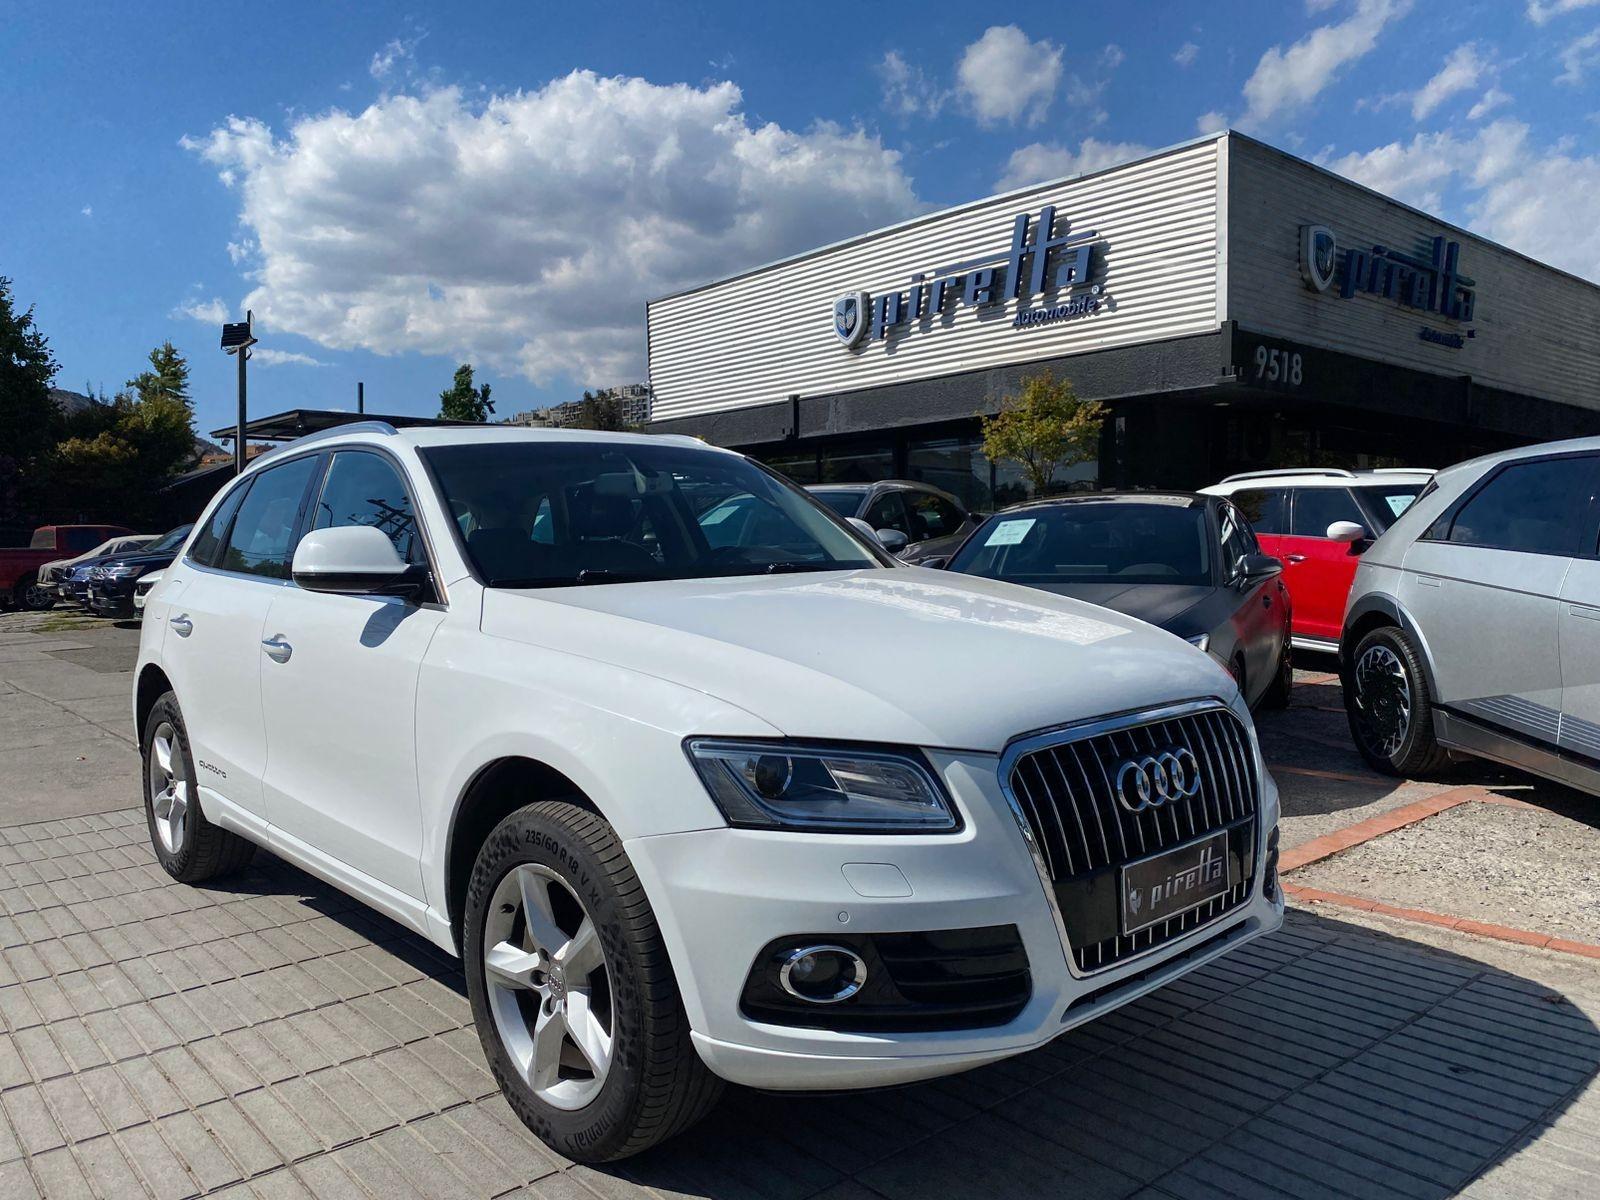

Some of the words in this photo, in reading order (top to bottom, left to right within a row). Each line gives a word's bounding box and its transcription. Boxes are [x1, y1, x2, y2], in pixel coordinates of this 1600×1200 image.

[872, 205, 1097, 341] piretta
[1013, 294, 1097, 326] Automobile
[1255, 345, 1303, 386] 9518
[525, 829, 559, 855] 235/60
[559, 847, 567, 863] R
[568, 855, 579, 875] 18
[1150, 846, 1223, 911] piretta
